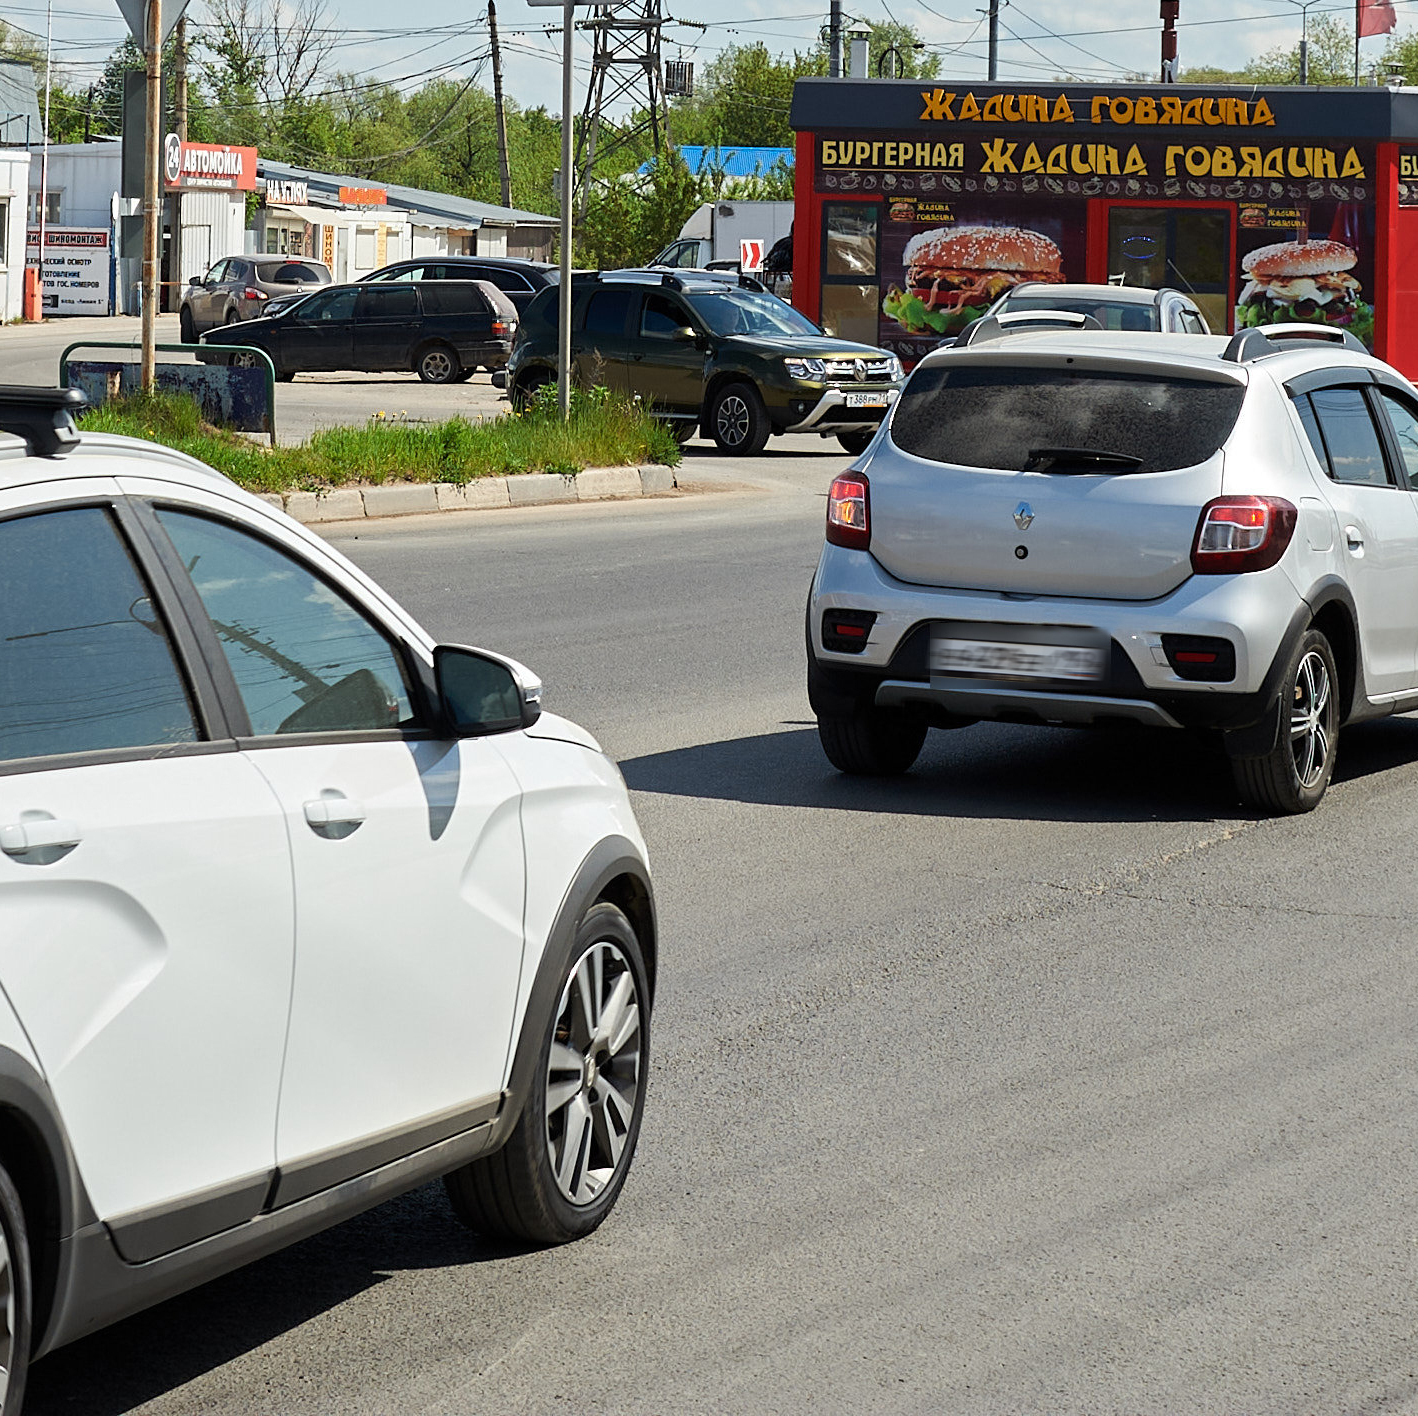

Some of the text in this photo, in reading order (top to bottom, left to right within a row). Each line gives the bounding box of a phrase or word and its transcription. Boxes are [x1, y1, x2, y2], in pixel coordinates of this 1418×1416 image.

[919, 88, 1276, 126] ЖАДИНА ГОВЯДИНА
[169, 146, 242, 174] 24 АВТОМОЙКА
[822, 138, 1367, 179] БУРГЕРНАЯ ЖАДИНА ГОВЯДИНА
[48, 234, 102, 244] ШИНОМОНТАЖ
[324, 225, 334, 270] ШИНОМ
